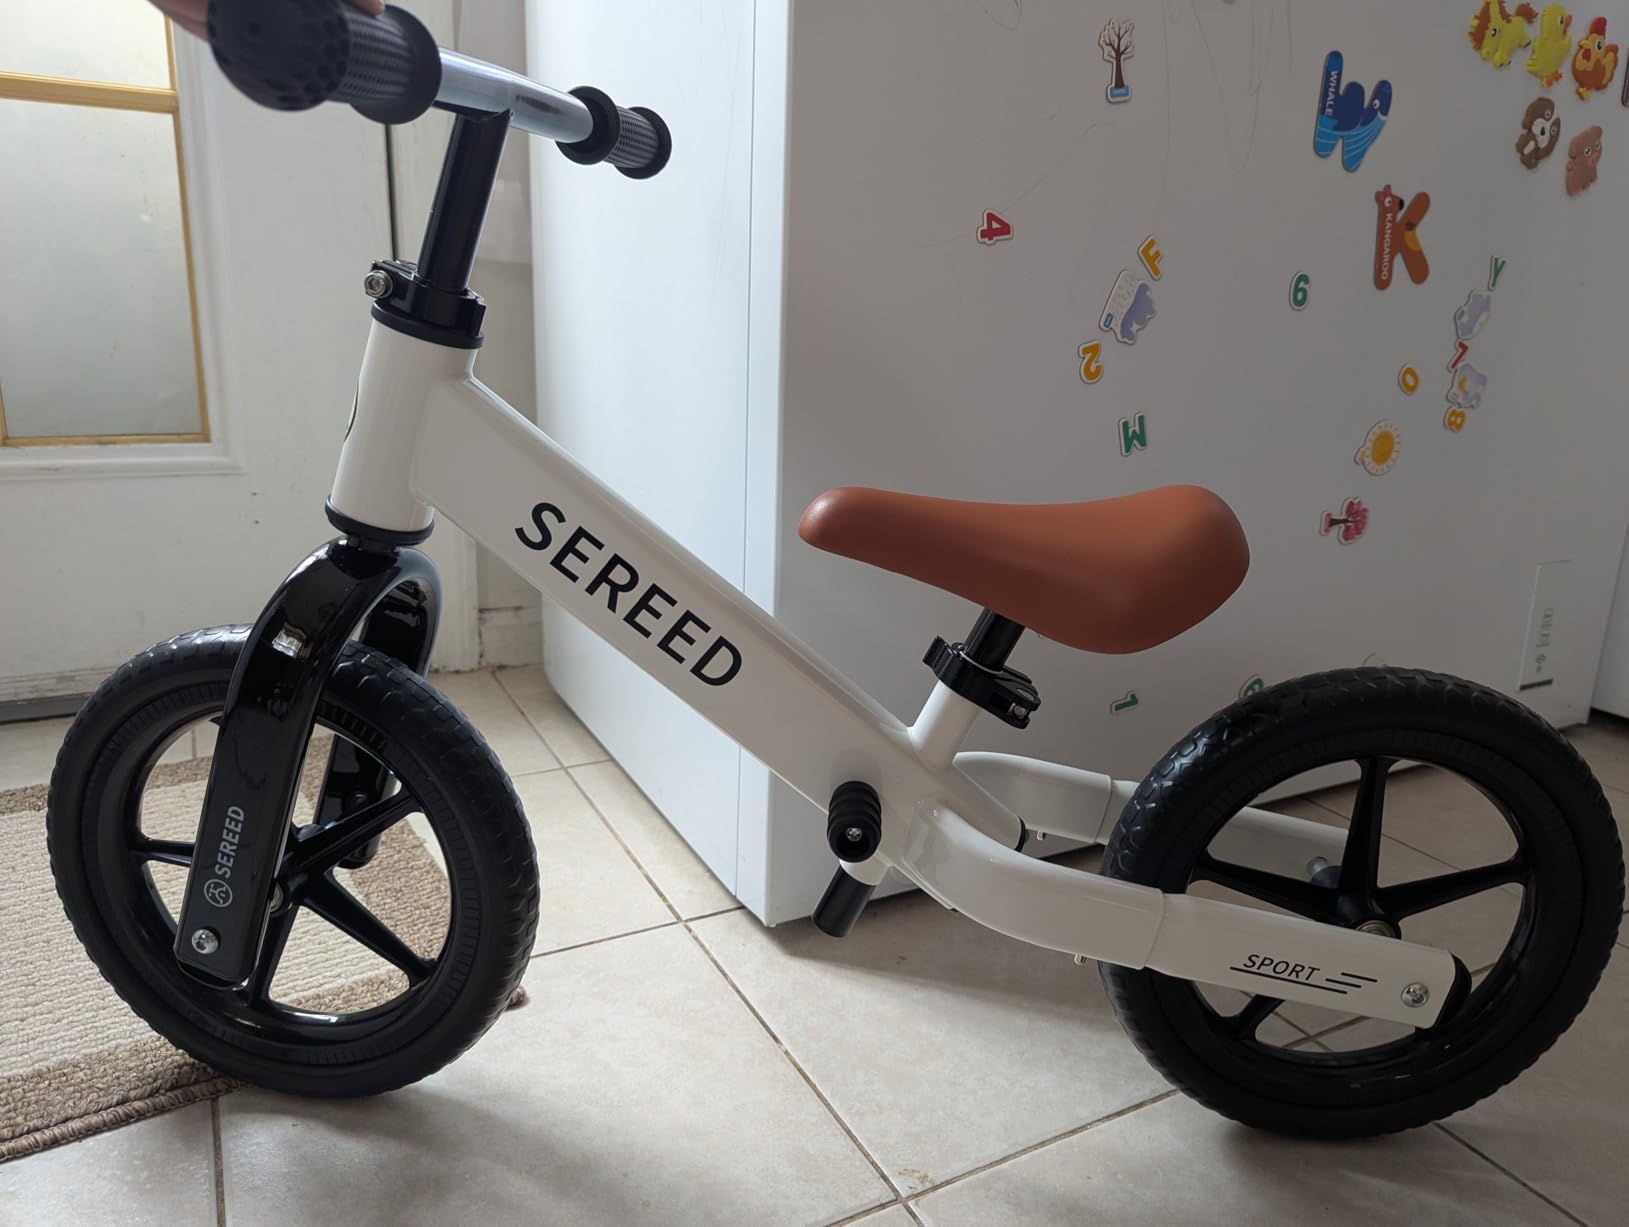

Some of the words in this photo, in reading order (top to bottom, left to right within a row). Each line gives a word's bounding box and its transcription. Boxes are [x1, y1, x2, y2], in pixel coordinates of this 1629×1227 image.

[1325, 70, 1339, 117] WHALE
[979, 211, 1012, 241] 4
[1380, 212, 1393, 281] KANGAROO
[1140, 238, 1162, 278] F
[1080, 342, 1103, 382] 2
[514, 502, 742, 687] SEREED
[214, 805, 245, 879] SEREED
[1243, 954, 1321, 981] SPORT
